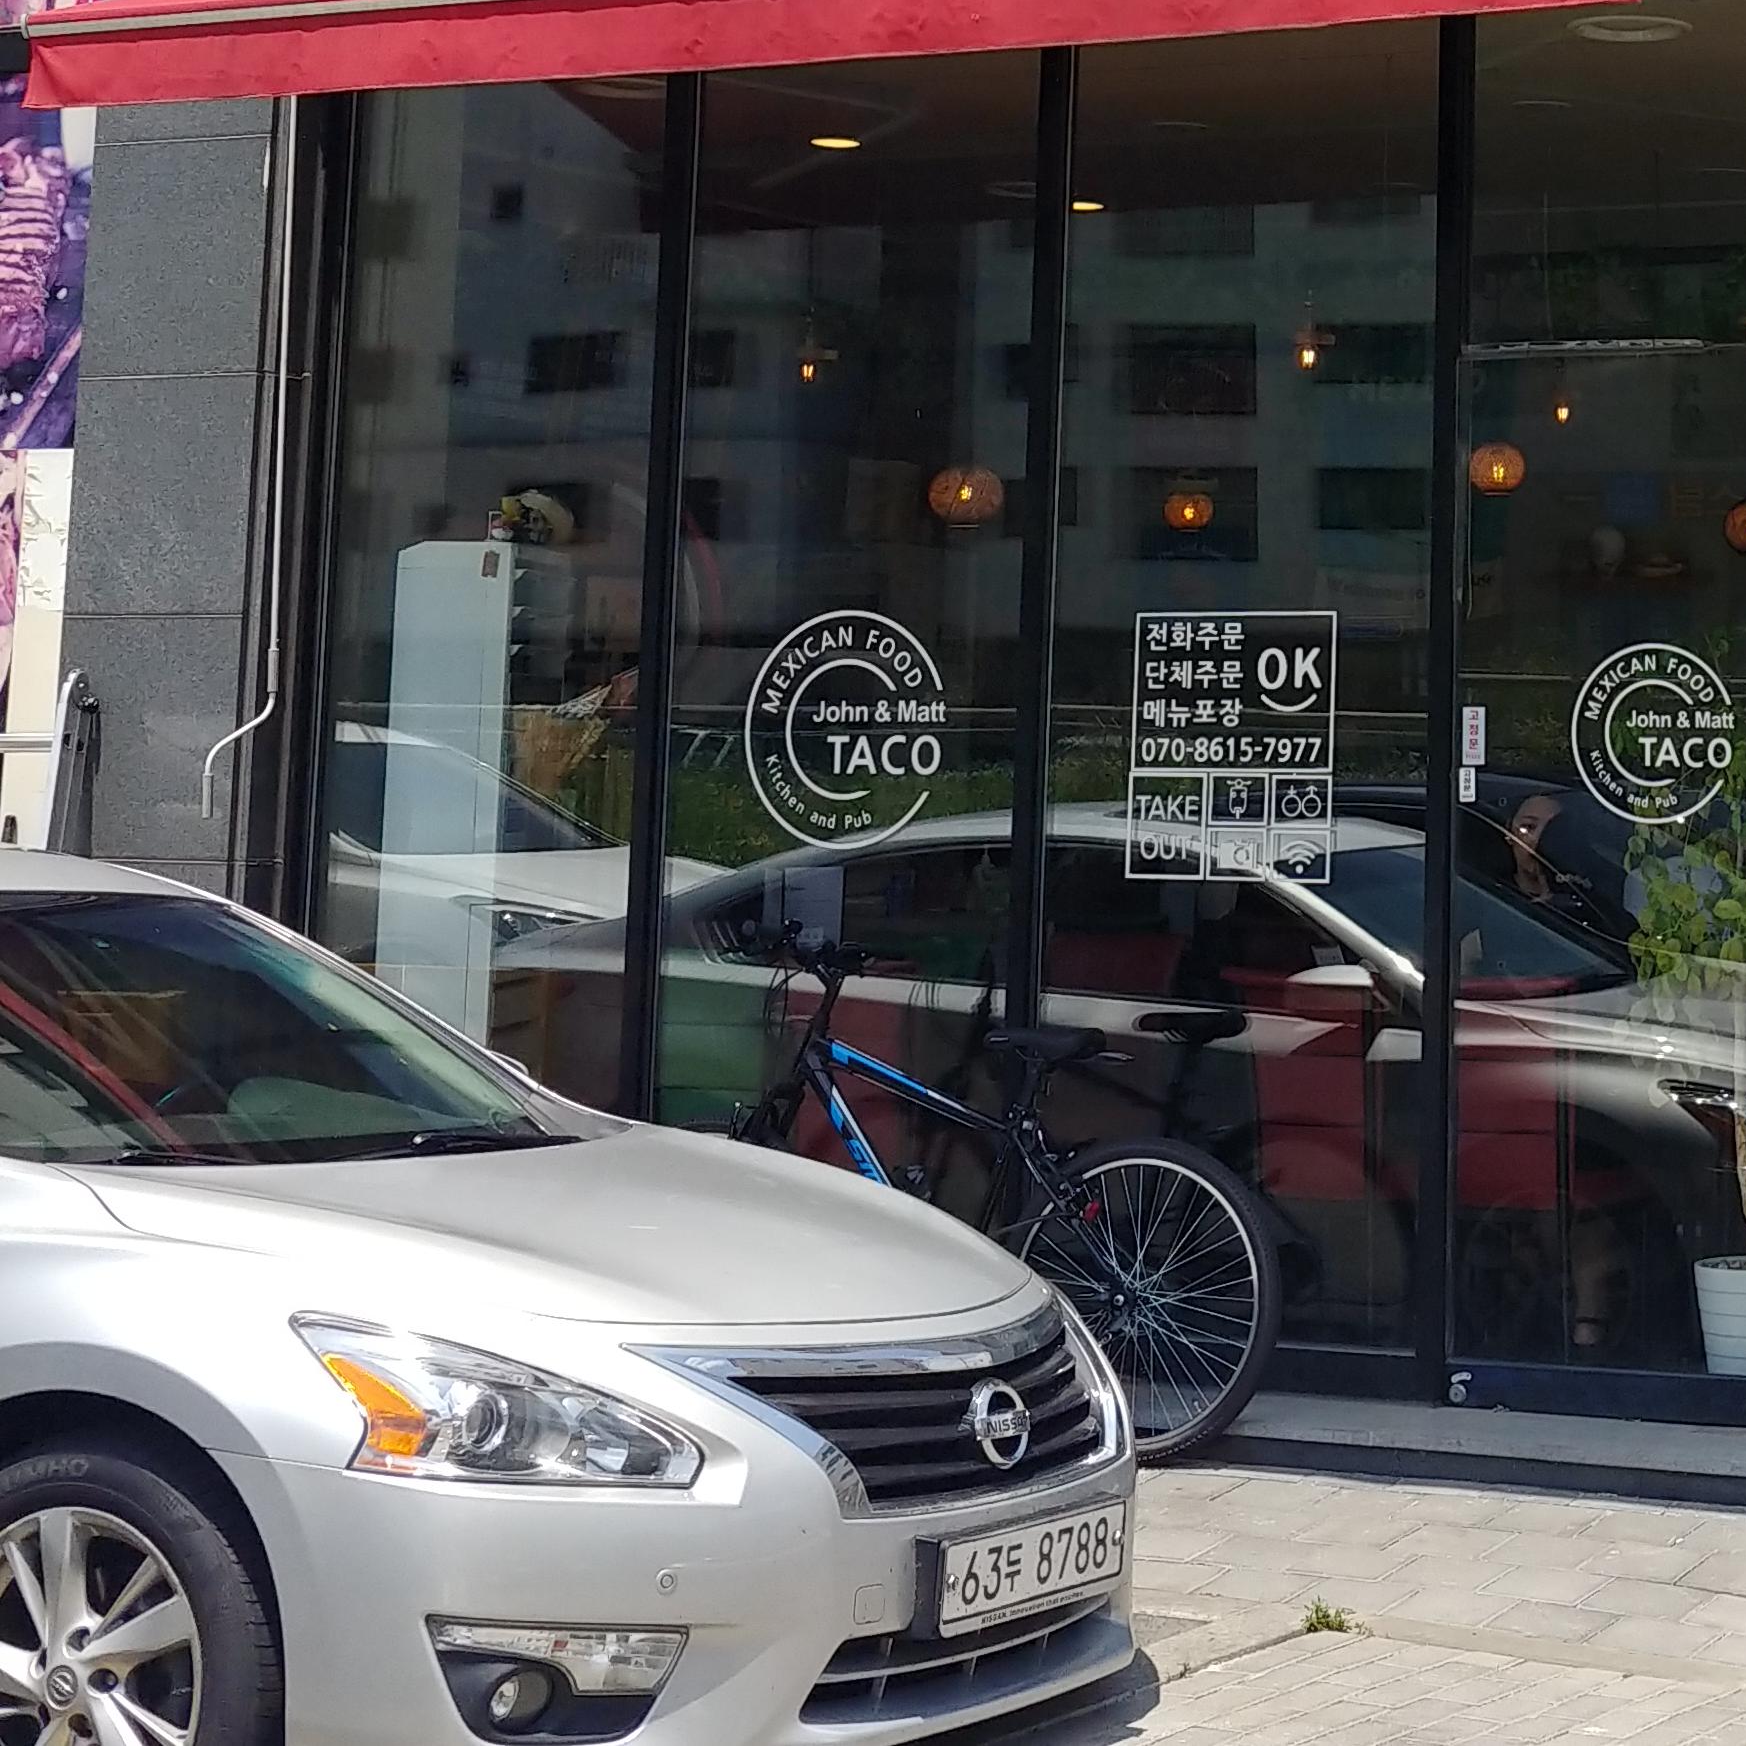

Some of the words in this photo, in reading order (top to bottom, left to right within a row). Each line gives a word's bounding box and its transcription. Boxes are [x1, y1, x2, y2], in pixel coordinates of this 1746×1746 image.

[1145, 622, 1245, 652] 전화주문
[761, 626, 853, 714] MEXICAN
[865, 629, 922, 687] FOOD
[1145, 660, 1244, 690] 단체주문
[1257, 647, 1322, 689] OK
[1584, 654, 1656, 720] MEXICAN
[1667, 658, 1714, 702] FOOD
[812, 700, 868, 722] John
[874, 700, 892, 722] &
[897, 700, 946, 722] Matt
[1142, 698, 1243, 728] 메뉴포장
[1626, 710, 1671, 728] John
[1676, 710, 1690, 729] &
[1695, 711, 1735, 729] Matt
[826, 735, 941, 775] TACO
[1141, 736, 1322, 762] 070-8615-7977
[1638, 737, 1732, 768] TACO
[765, 753, 804, 814] Kitchen
[810, 810, 836, 830] and
[844, 809, 872, 829] Pub
[1590, 750, 1624, 797] Kitchen
[1627, 794, 1649, 808] and
[1655, 793, 1678, 808] Pub
[1135, 795, 1200, 821] TAKE
[1140, 835, 1193, 860] OUT
[1036, 1516, 1109, 1585] 8788
